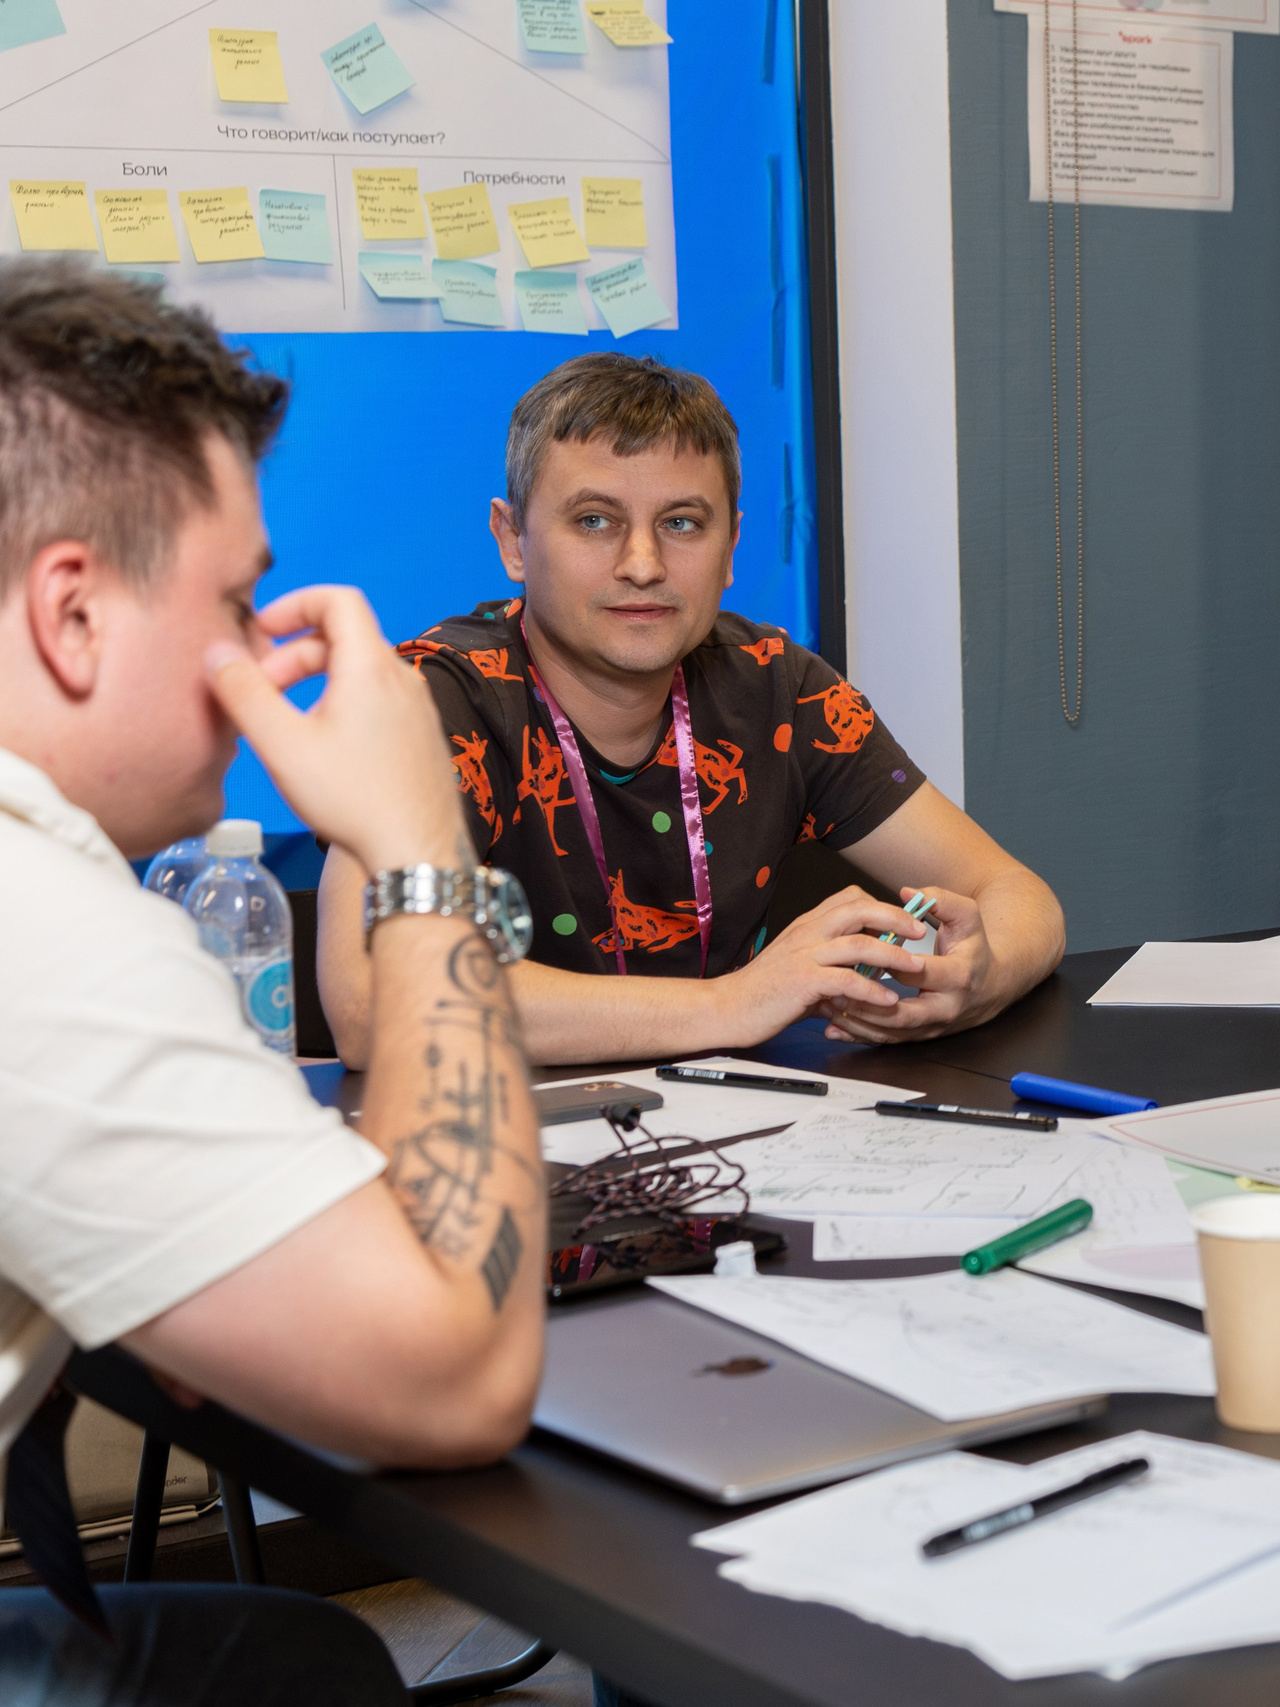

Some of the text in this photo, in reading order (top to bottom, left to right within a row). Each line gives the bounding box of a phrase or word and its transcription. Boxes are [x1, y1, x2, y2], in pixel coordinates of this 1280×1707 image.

[217, 125, 446, 146] Что говорит/как поступает?
[122, 160, 168, 177] Боли
[463, 170, 566, 187] Потребности
